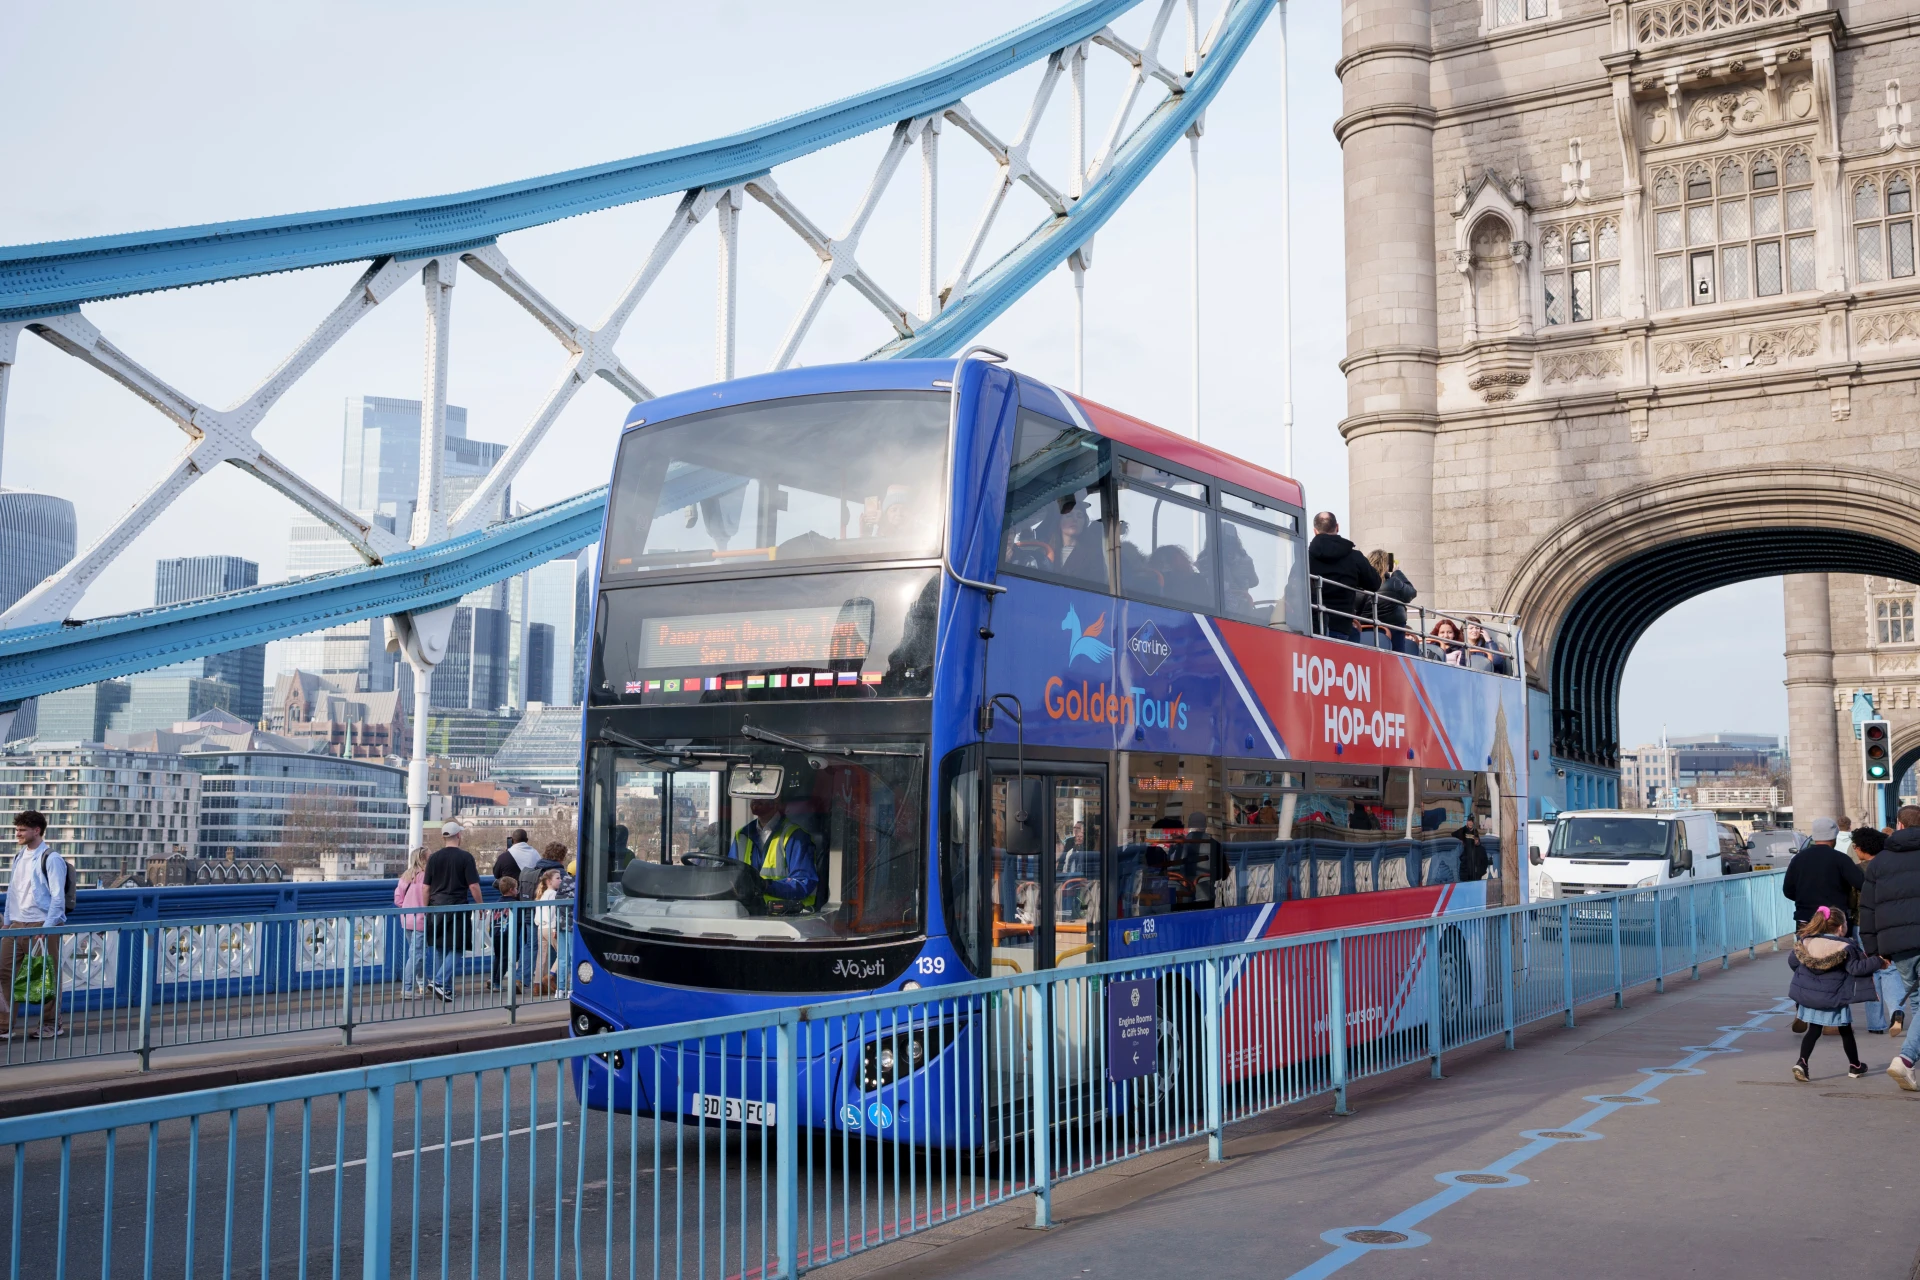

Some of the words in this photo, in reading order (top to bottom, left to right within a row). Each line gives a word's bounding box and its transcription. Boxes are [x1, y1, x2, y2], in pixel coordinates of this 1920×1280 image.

[659, 625, 738, 646] Panoramic
[742, 621, 779, 641] Open
[785, 618, 814, 639] Top
[701, 646, 727, 664] See
[734, 643, 760, 662] the
[1293, 652, 1371, 702] HOP-ON
[1324, 704, 1405, 749] HOP-OFF
[1143, 918, 1155, 933] 139
[603, 952, 640, 964] VOLVO
[915, 957, 946, 974] 139
[1118, 1016, 1135, 1028] Engine
[1136, 1014, 1152, 1024] Rooms
[1121, 1029, 1126, 1038] &
[1127, 1028, 1136, 1037] Gift
[1137, 1027, 1150, 1037] Shop
[701, 1097, 732, 1117] BD6
